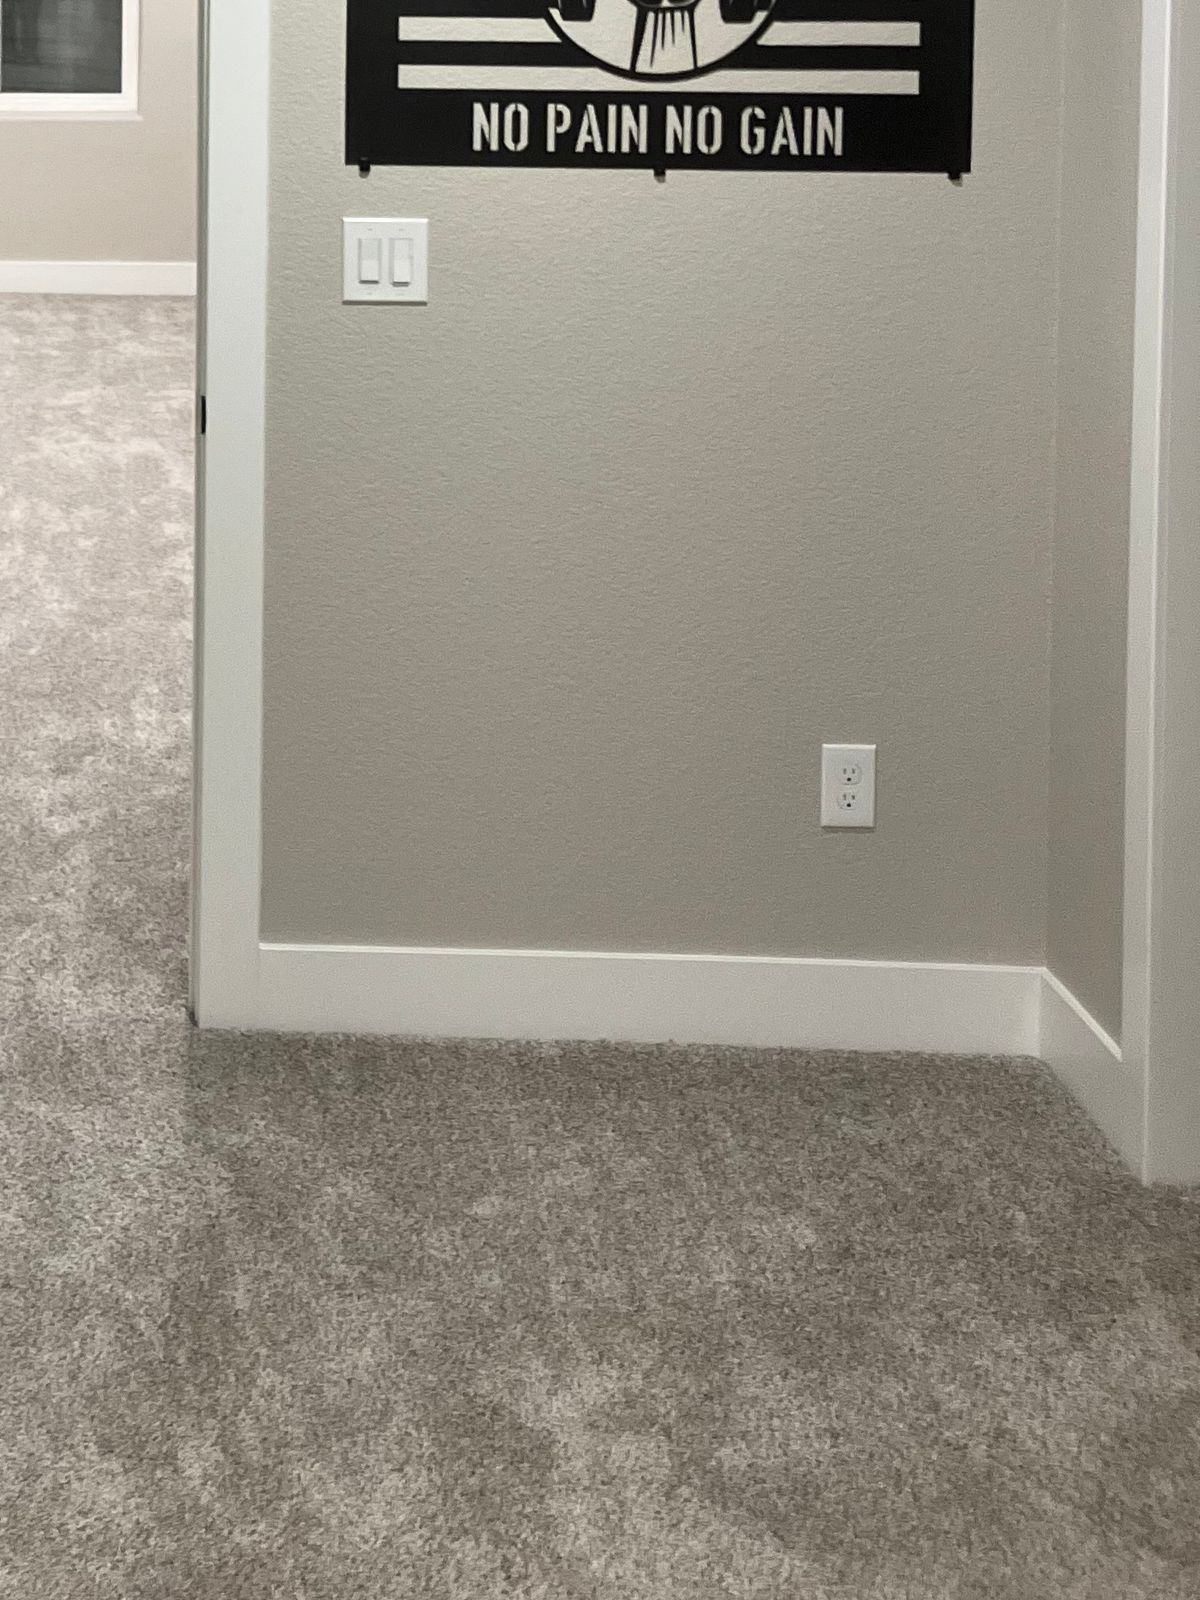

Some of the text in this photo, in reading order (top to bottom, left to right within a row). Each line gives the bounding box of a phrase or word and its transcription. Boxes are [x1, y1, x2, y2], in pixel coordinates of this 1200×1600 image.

[471, 101, 845, 157] NO PAIN NO GAIN
